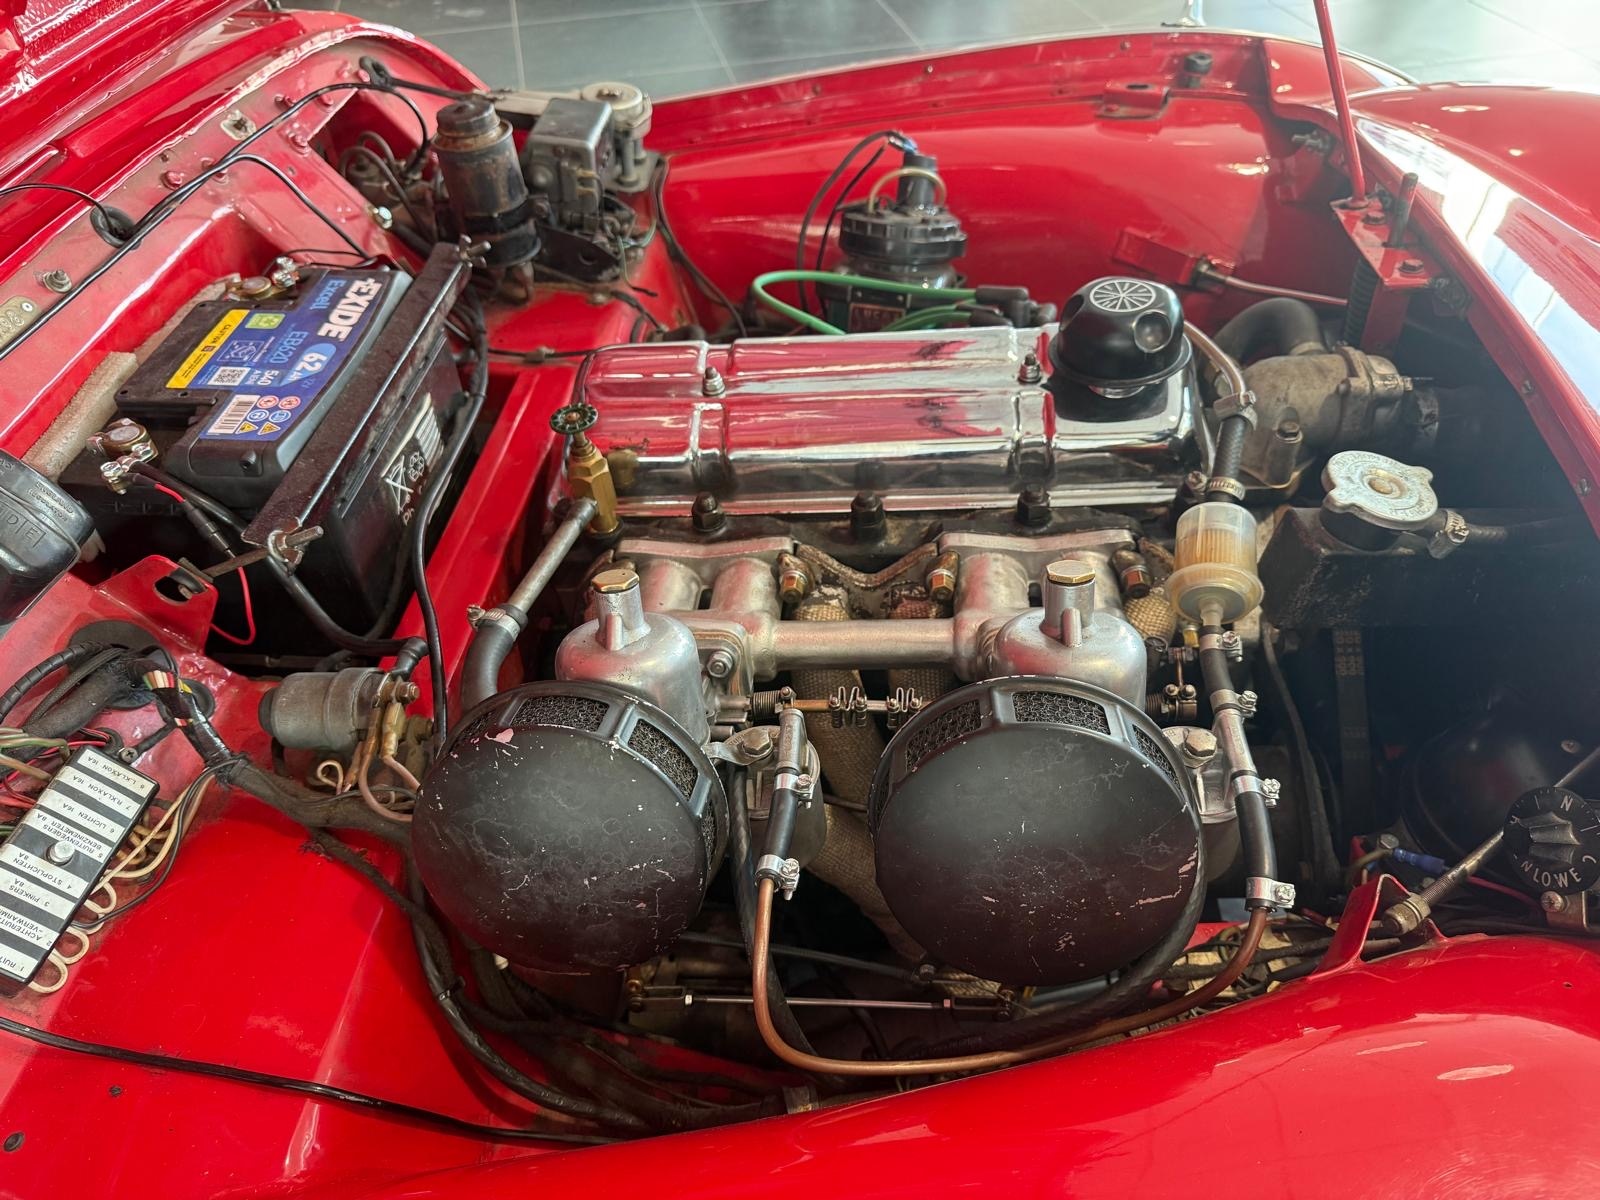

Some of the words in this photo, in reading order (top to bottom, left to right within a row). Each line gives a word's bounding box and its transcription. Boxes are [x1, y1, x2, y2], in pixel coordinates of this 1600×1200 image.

[310, 279, 346, 310] Excell
[317, 278, 382, 341] EXIDE
[270, 331, 309, 363] EB620
[295, 352, 328, 372] 62
[257, 370, 279, 386] 540
[36, 481, 73, 513] ENGLAND
[78, 811, 107, 829] LICHTEN
[51, 820, 103, 850] BENZINEMETER
[19, 852, 30, 861] 8A
[13, 858, 63, 885] STOPLICHTEN
[14, 878, 25, 888] 8A
[1519, 858, 1583, 888] NLOWE
[9, 885, 41, 903] PINKERS
[0, 918, 42, 941] ACHTERUIT
